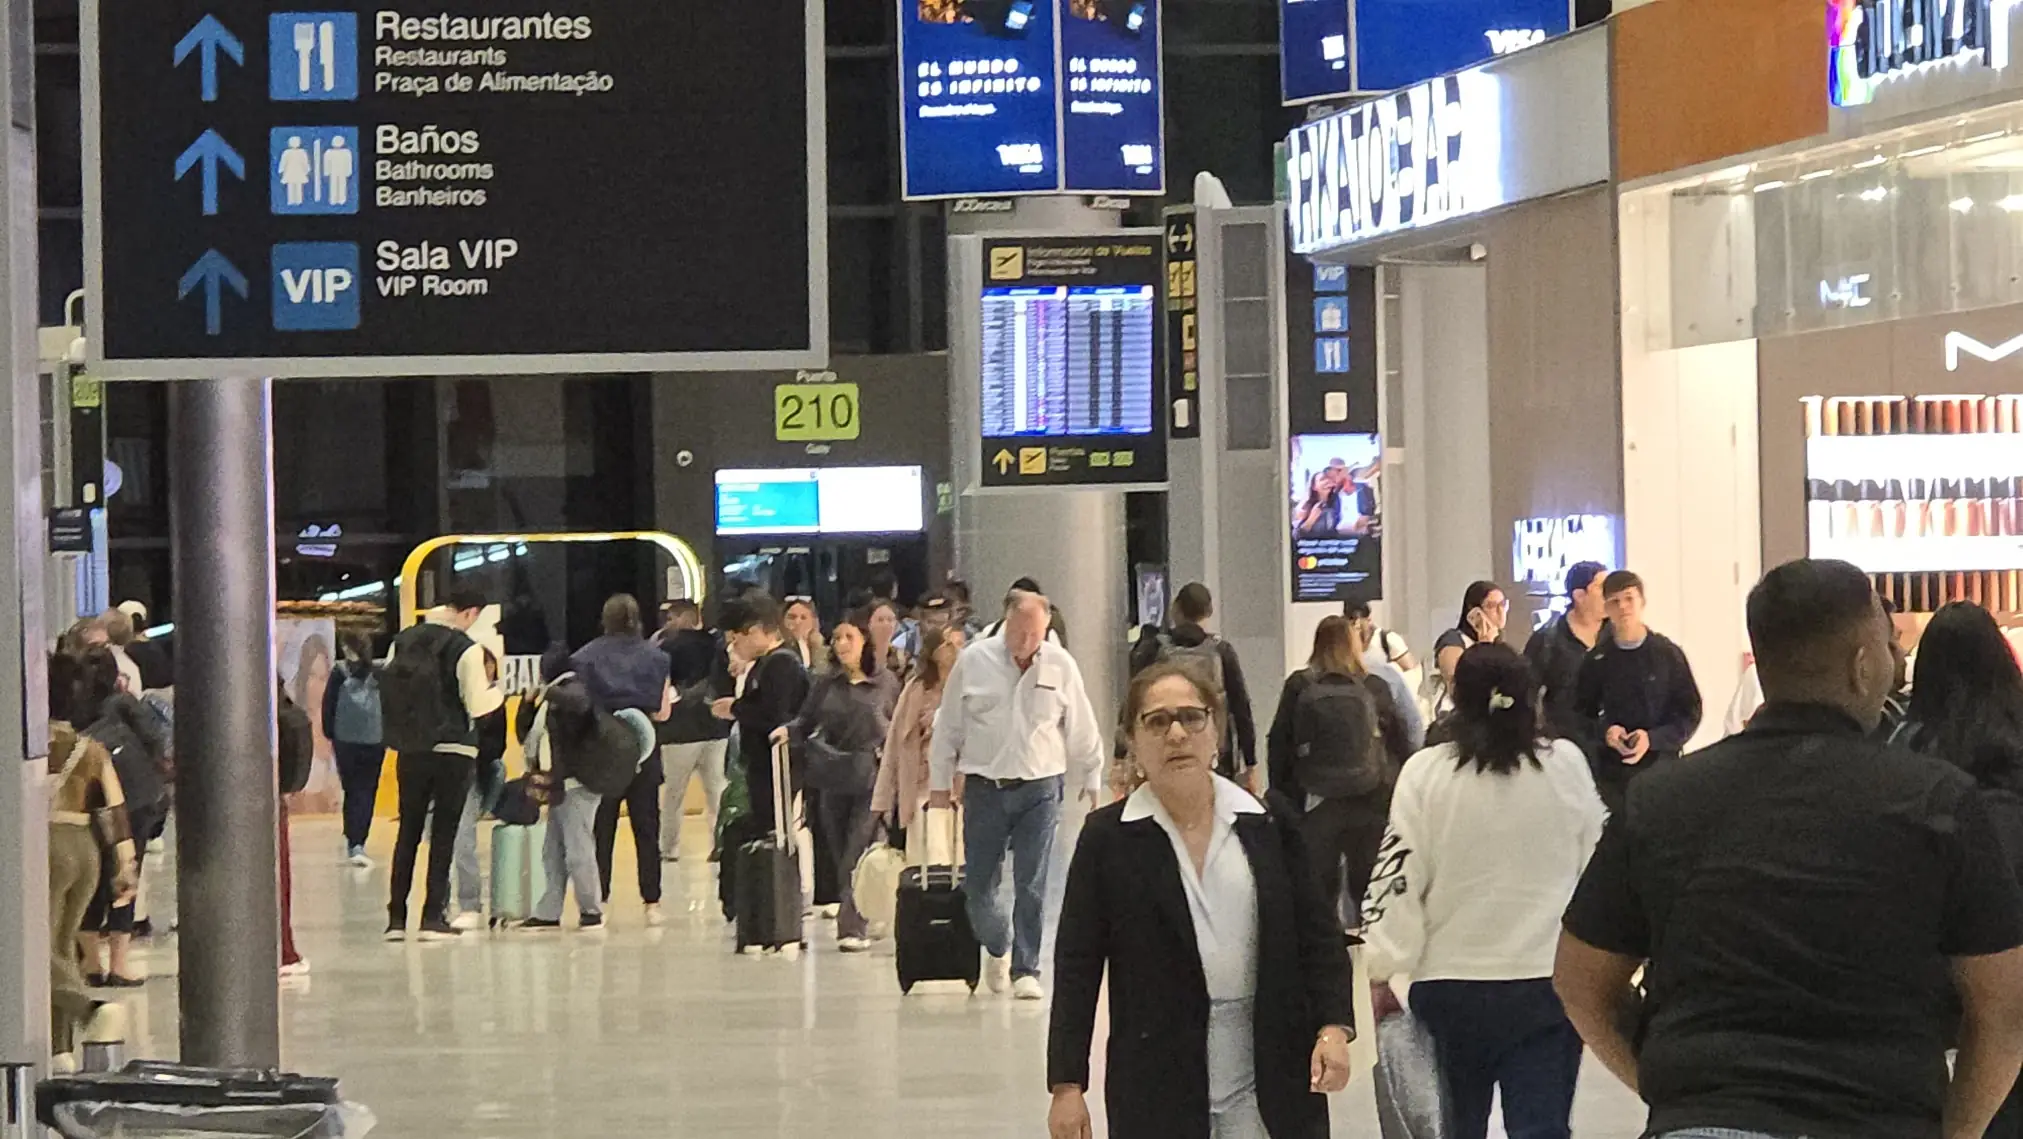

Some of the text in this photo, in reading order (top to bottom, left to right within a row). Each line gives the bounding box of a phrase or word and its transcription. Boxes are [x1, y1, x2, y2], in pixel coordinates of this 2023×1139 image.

[375, 10, 593, 41] Restaurantes
[374, 45, 507, 67] Restaurants
[374, 70, 615, 97] Praça de Alimentação
[375, 124, 480, 154] Baños
[375, 160, 494, 181] Bathrooms
[375, 185, 487, 207] Banheiros
[375, 239, 518, 271] Sala VIP
[280, 268, 353, 304] VIP
[375, 274, 489, 297] VIP Room
[781, 393, 853, 430] 210
